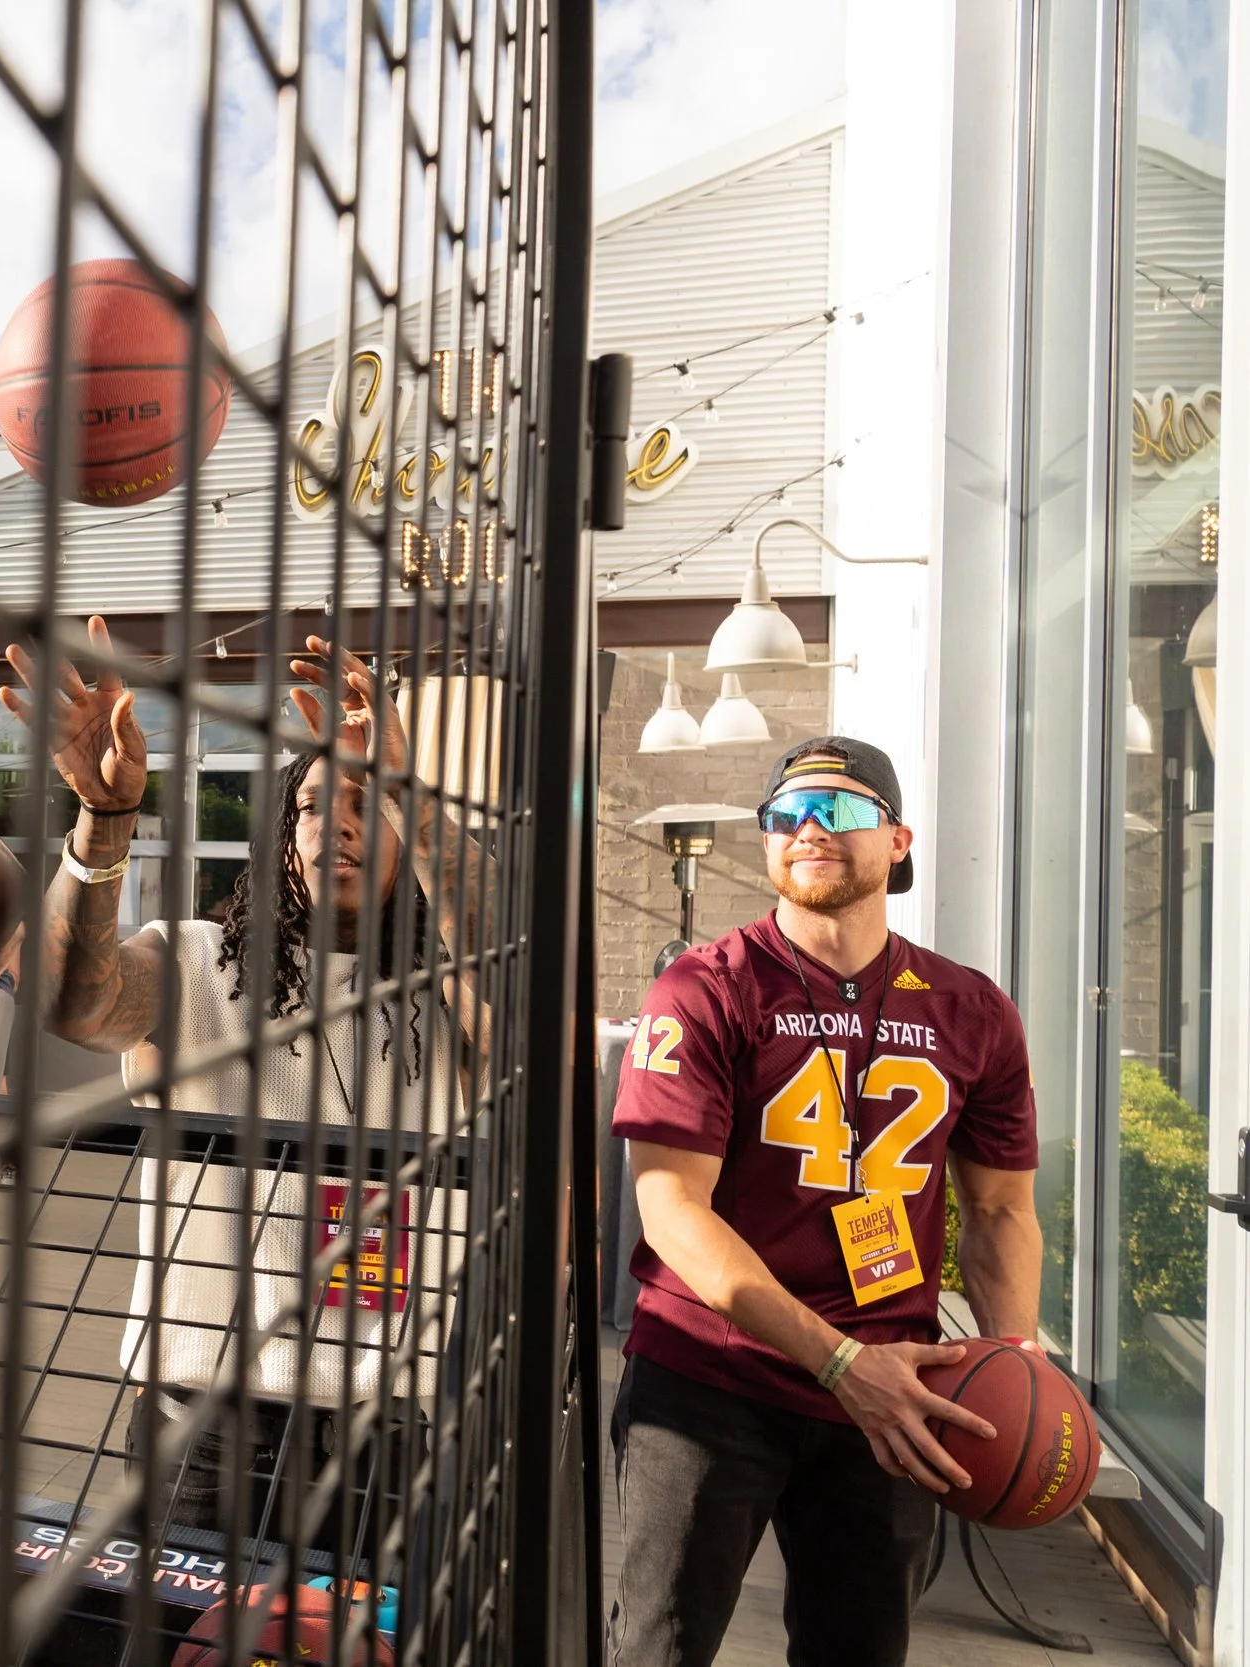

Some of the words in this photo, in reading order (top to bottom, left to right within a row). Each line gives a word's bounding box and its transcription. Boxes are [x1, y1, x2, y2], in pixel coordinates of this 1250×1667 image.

[893, 980, 931, 990] adidas
[774, 1012, 863, 1038] ARIZONA
[876, 1019, 937, 1051] STATE
[631, 1014, 683, 1075] 42
[760, 1046, 950, 1196] 42
[847, 1209, 888, 1235] TEMPE
[870, 1259, 896, 1278] VIP
[1027, 1411, 1073, 1516] BASKETBALL
